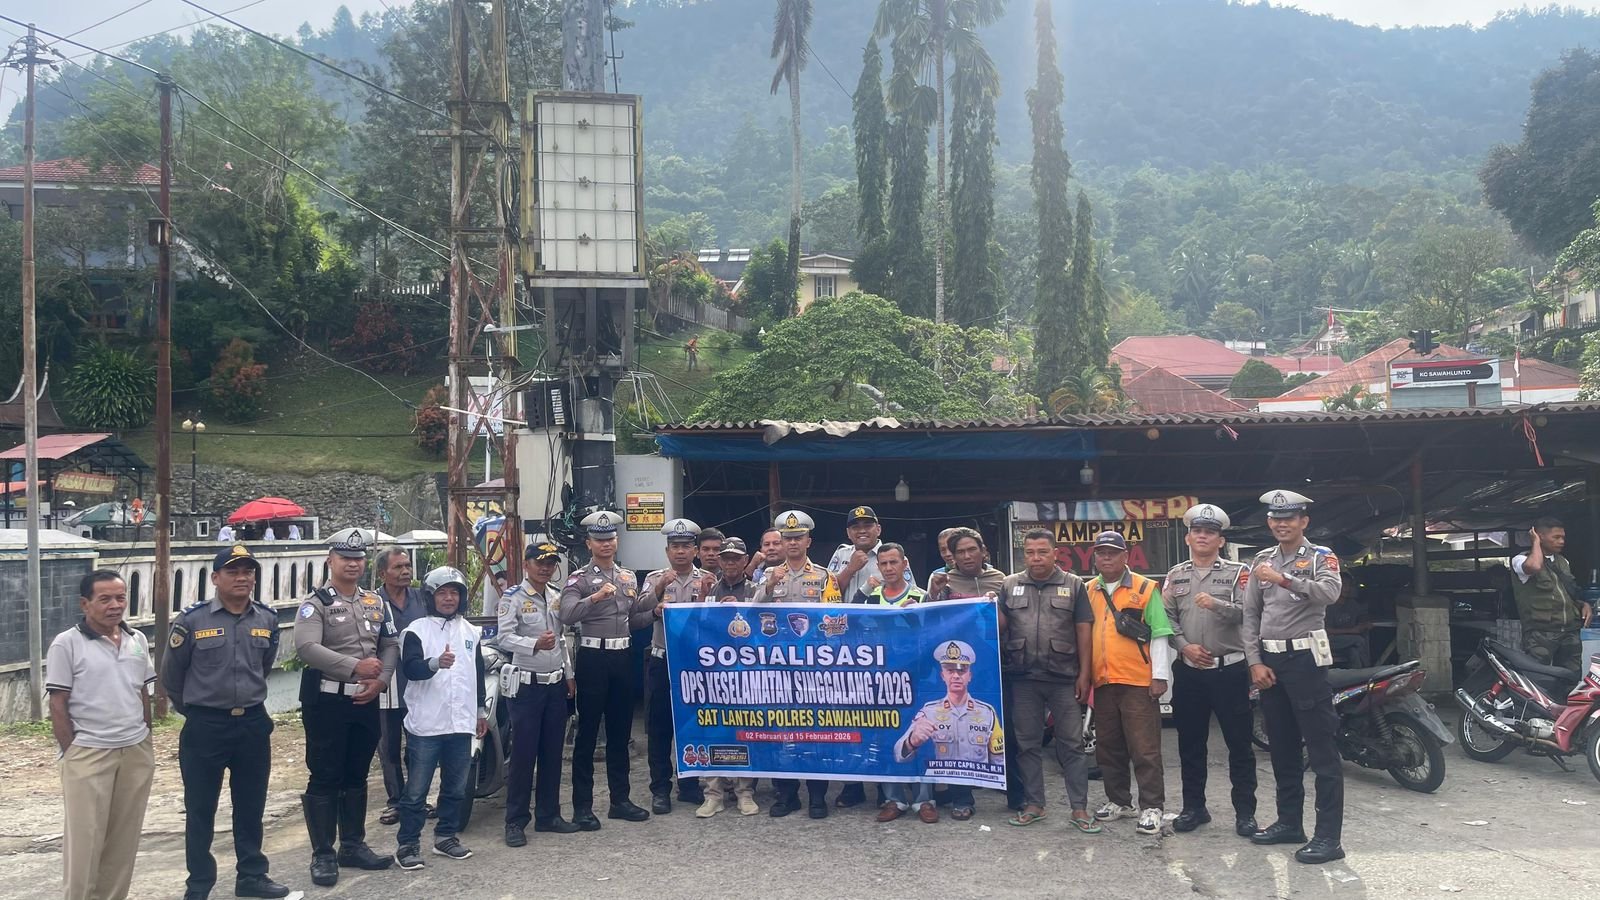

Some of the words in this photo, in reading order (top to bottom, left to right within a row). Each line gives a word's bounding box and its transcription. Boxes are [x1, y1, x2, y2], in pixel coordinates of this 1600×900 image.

[1058, 521, 1141, 541] AMPERA
[698, 645, 884, 667] SOSIALISASI
[680, 670, 706, 704] OPS
[705, 670, 794, 705] KESELAMATAN
[794, 670, 875, 705] SINGGALANG
[875, 671, 913, 705] 2026
[697, 709, 718, 726] SAT
[721, 709, 765, 727] LANTAS
[767, 709, 814, 727] POLRES
[817, 709, 900, 728] SAWAHLUNTO
[745, 732, 754, 740] 02
[755, 732, 781, 740] Februari
[783, 732, 793, 740] s/d
[795, 732, 804, 740] 15
[805, 732, 833, 740] Februari
[834, 732, 851, 740] 2026
